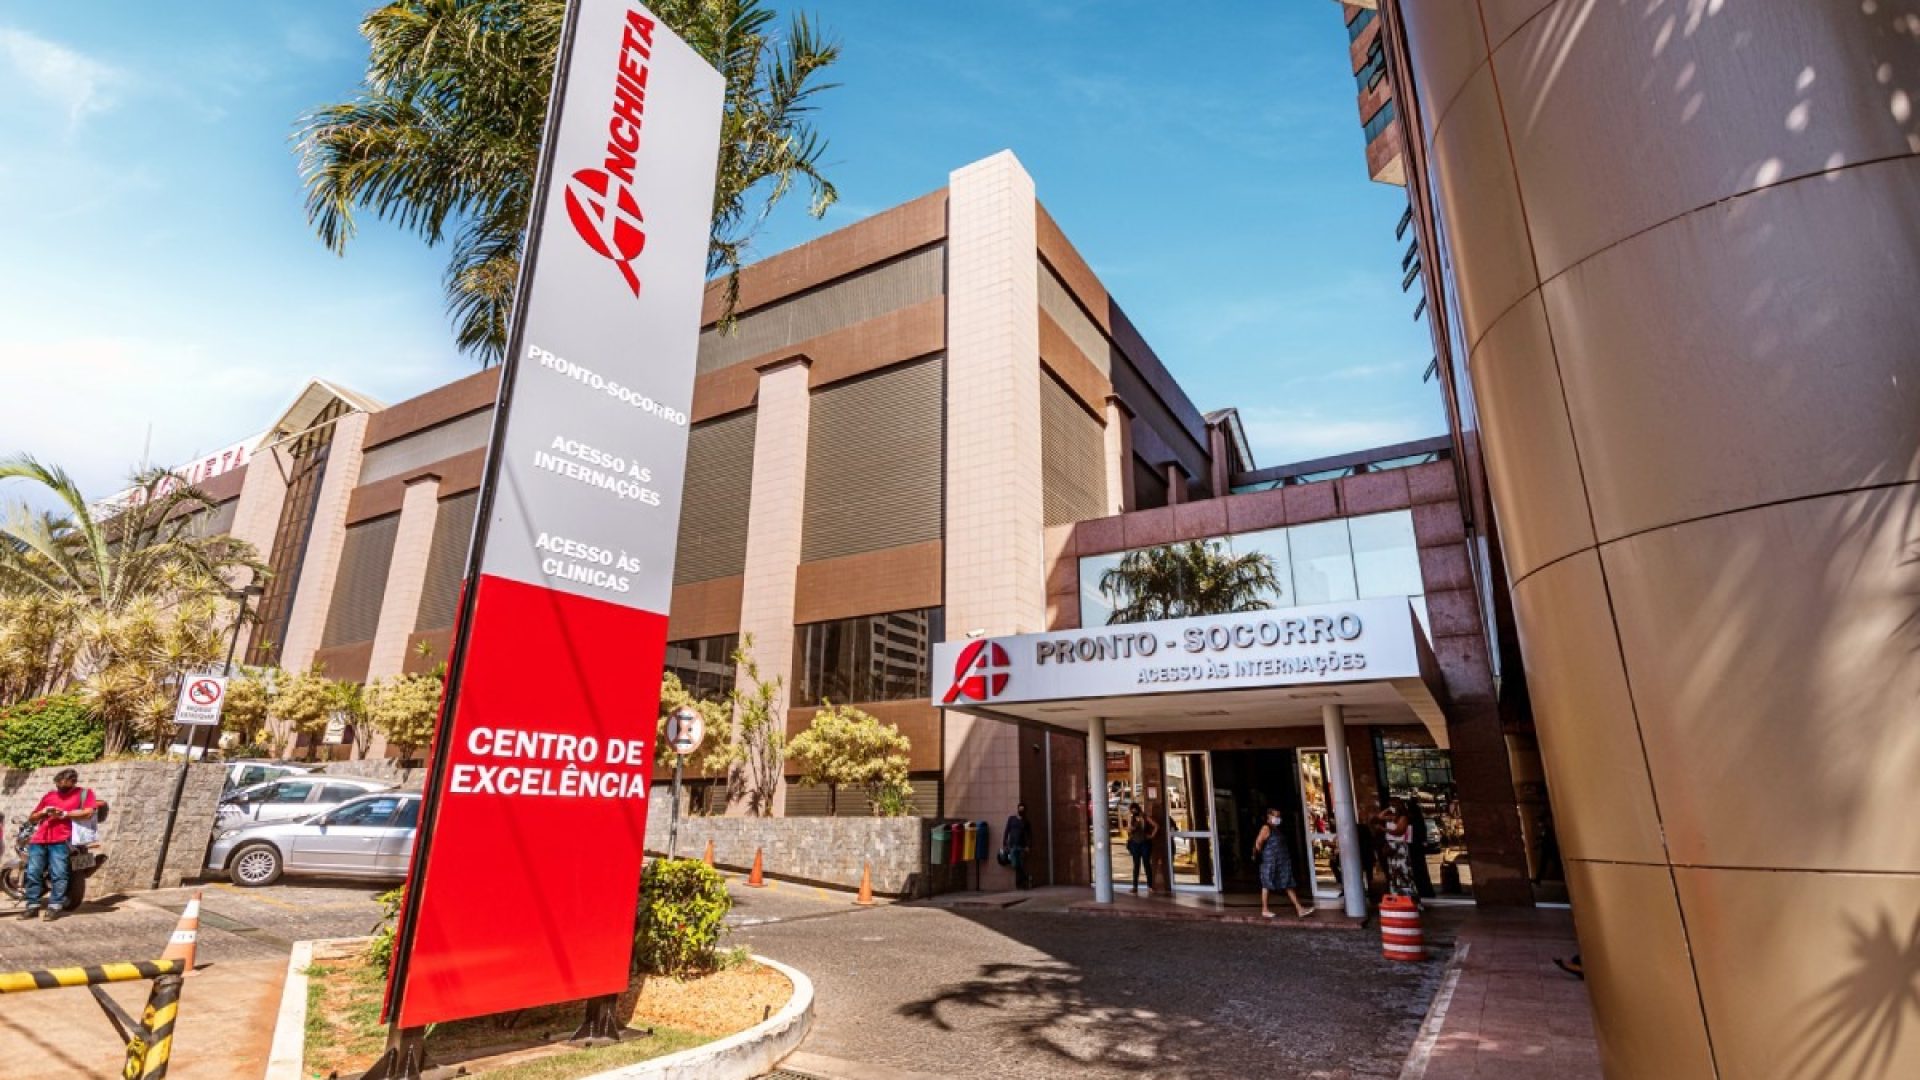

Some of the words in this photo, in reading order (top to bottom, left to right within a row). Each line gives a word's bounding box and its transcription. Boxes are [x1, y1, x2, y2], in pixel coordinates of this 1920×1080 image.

[527, 344, 687, 427] PRONTO-SOCORRO
[534, 450, 662, 508] INTERNAÇÕES
[551, 435, 626, 473] ACESSO
[627, 459, 653, 483] ÀS
[535, 531, 614, 567] ACESSO
[615, 549, 642, 575] ÀS
[1036, 631, 1158, 665] PRONTO
[1183, 612, 1363, 654] SOCORRO
[1137, 666, 1203, 684] ACESSO
[1207, 657, 1230, 680] ÀS
[1234, 651, 1368, 678] INTERNAÇÕES
[466, 726, 600, 763] CENTRO
[605, 738, 646, 766] DE
[450, 763, 647, 799] EXCELÊNCIA
